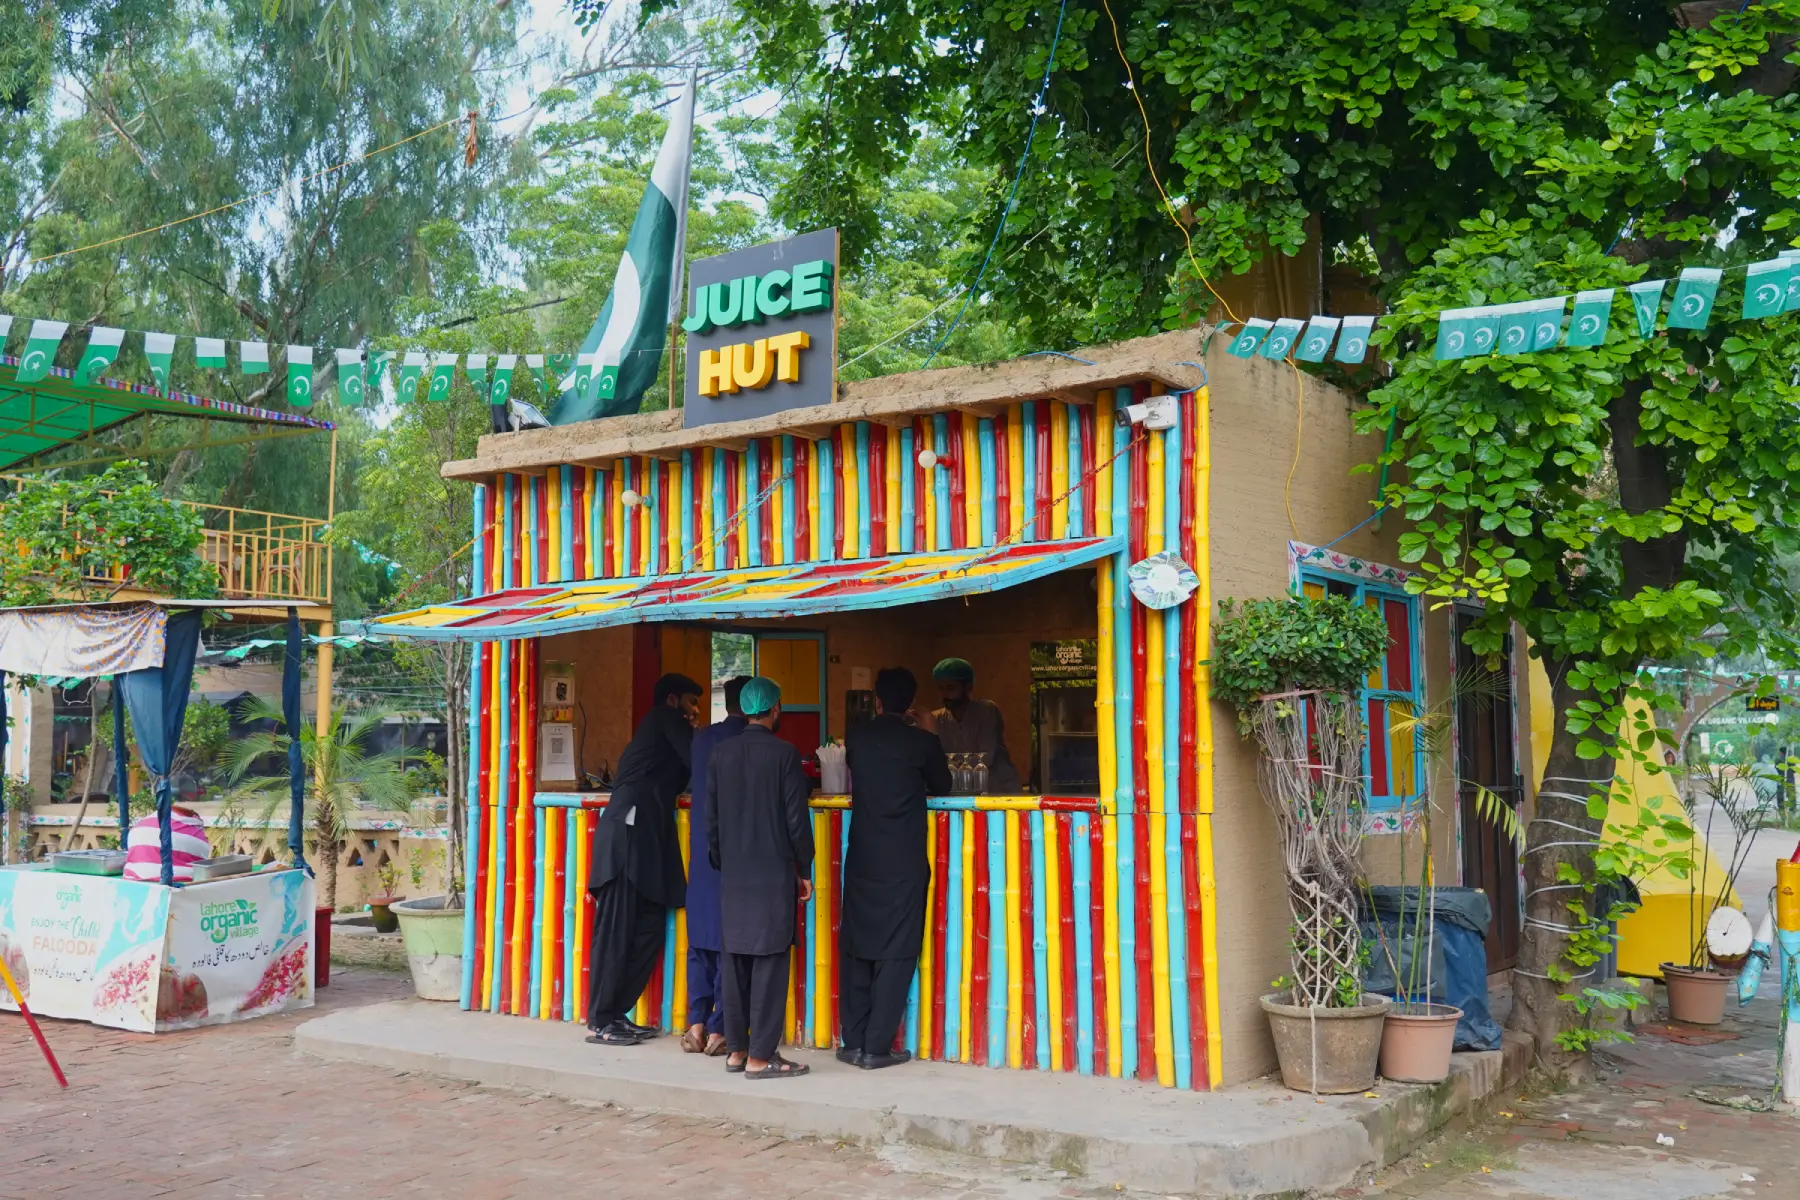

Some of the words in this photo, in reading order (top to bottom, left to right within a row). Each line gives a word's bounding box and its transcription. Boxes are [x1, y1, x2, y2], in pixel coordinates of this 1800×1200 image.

[682, 260, 832, 334] JUICE
[698, 331, 810, 397] HUT
[1055, 651, 1082, 664] organic
[201, 902, 236, 915] lahore
[31, 918, 54, 928] ENJOY
[58, 920, 69, 930] THE
[201, 909, 257, 943] organic
[230, 926, 259, 938] village
[33, 935, 97, 955] FALOODA
[249, 940, 269, 960] خالص
